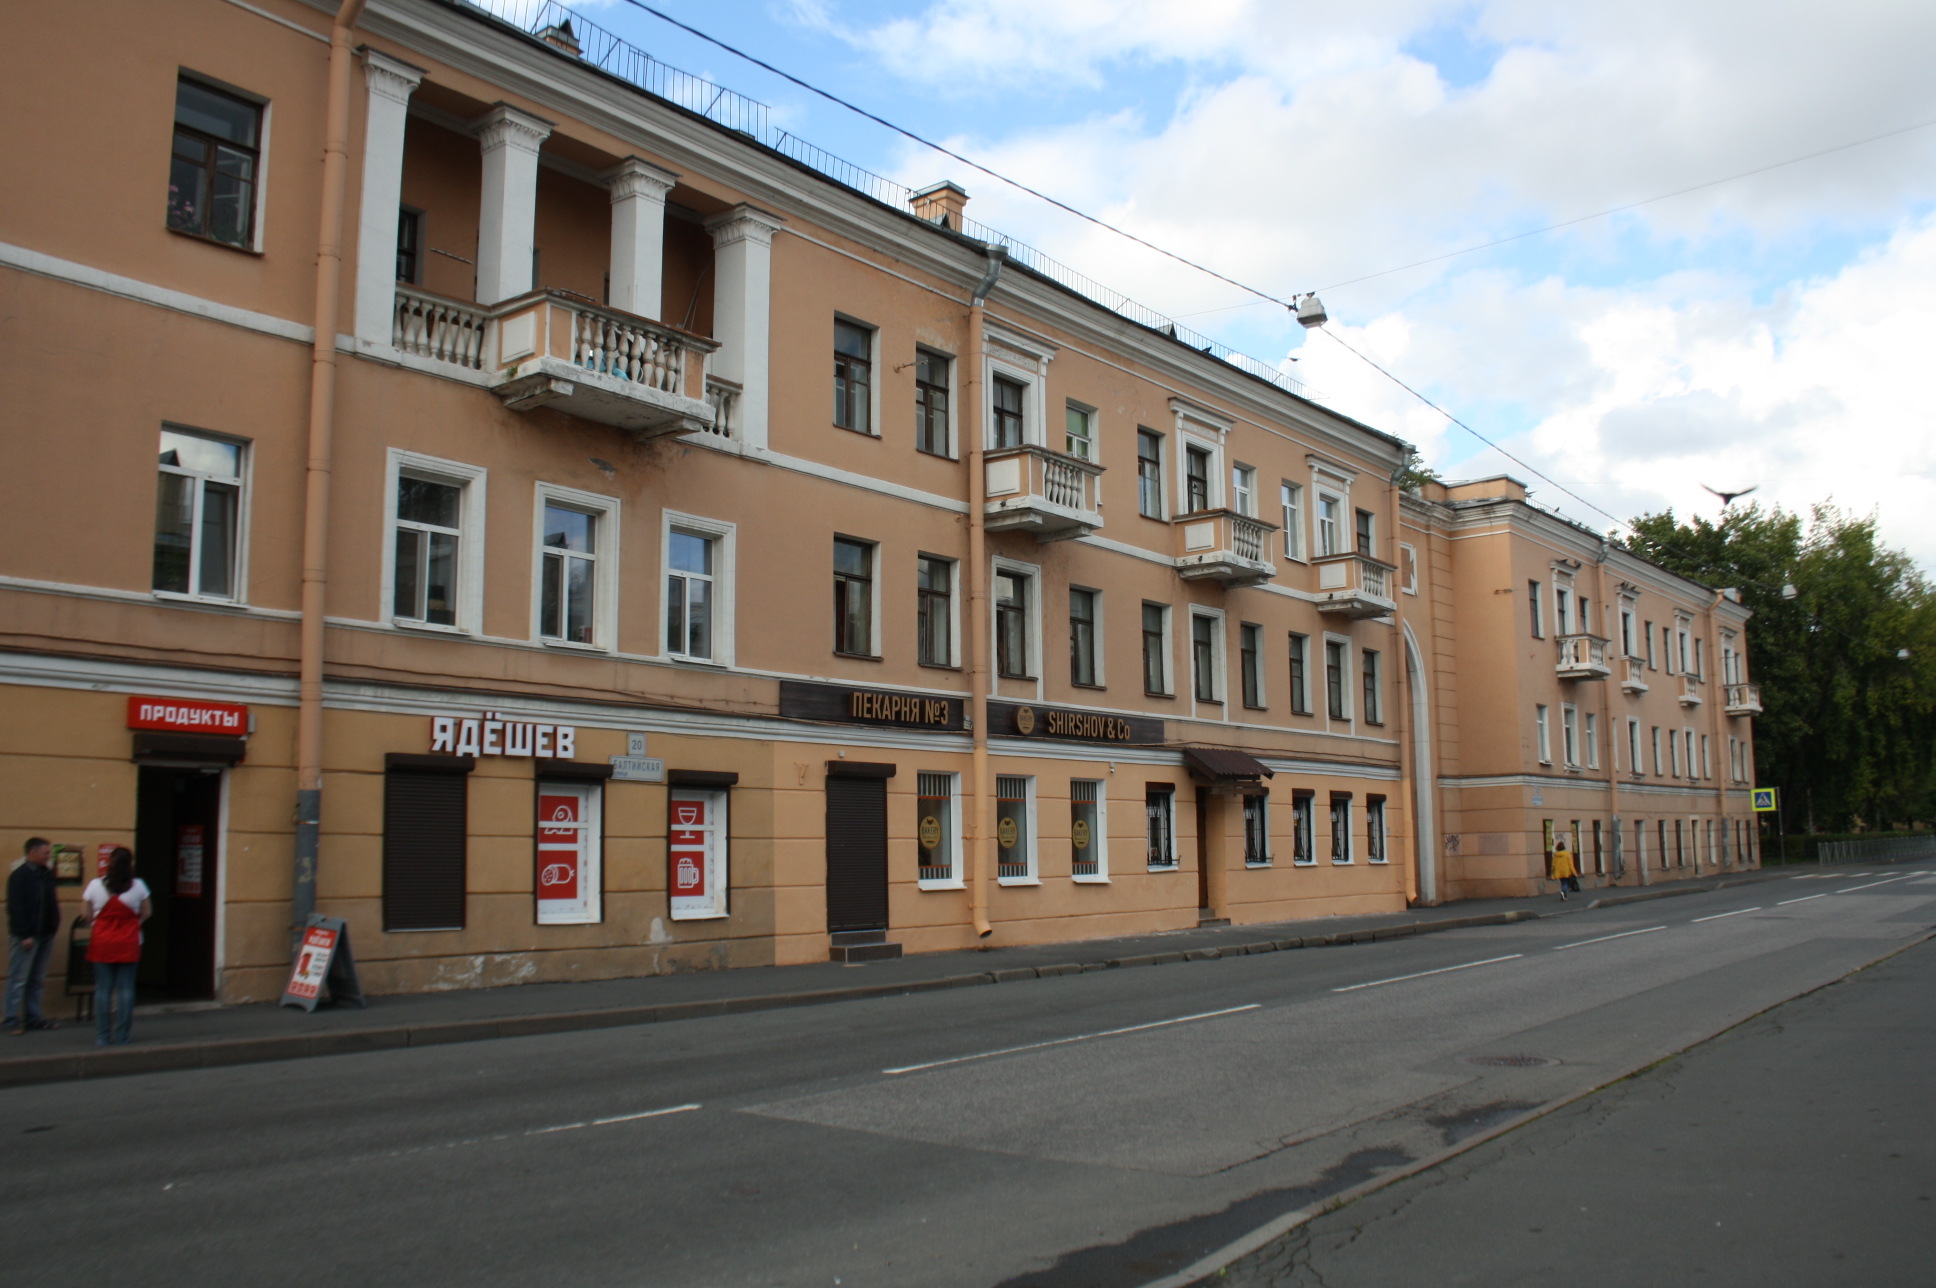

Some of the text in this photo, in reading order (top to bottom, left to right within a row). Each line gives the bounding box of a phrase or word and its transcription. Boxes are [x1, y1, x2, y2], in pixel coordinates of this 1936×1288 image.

[852, 691, 949, 725] ПЕКАРНЯ №3
[140, 704, 239, 728] ПРОДУКТЫ
[1048, 711, 1131, 740] SHIRSHOV & Co
[430, 711, 575, 759] ЯДЁШЕВ
[631, 739, 643, 751] 20
[613, 759, 660, 772] БАЛТИЙСКАЯ
[921, 826, 939, 836] BAKERY
[999, 826, 1016, 836] BAKERY
[1073, 829, 1088, 838] BAKERY
